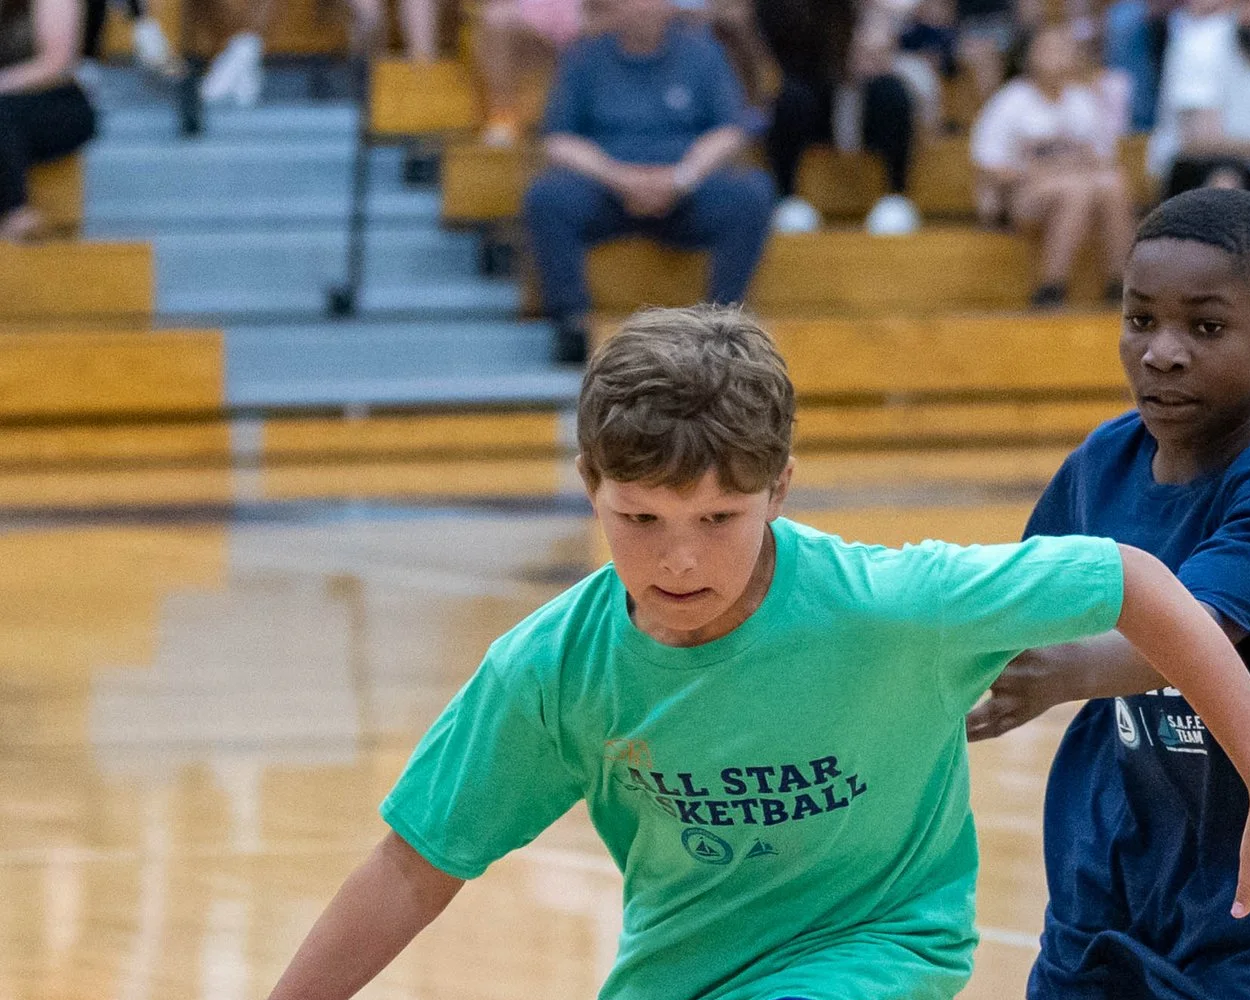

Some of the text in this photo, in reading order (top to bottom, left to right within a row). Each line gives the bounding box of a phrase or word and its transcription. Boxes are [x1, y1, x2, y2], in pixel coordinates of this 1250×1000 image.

[1175, 729, 1204, 745] TEAM
[720, 755, 843, 796] STAR
[614, 773, 868, 827] SKETBALL
